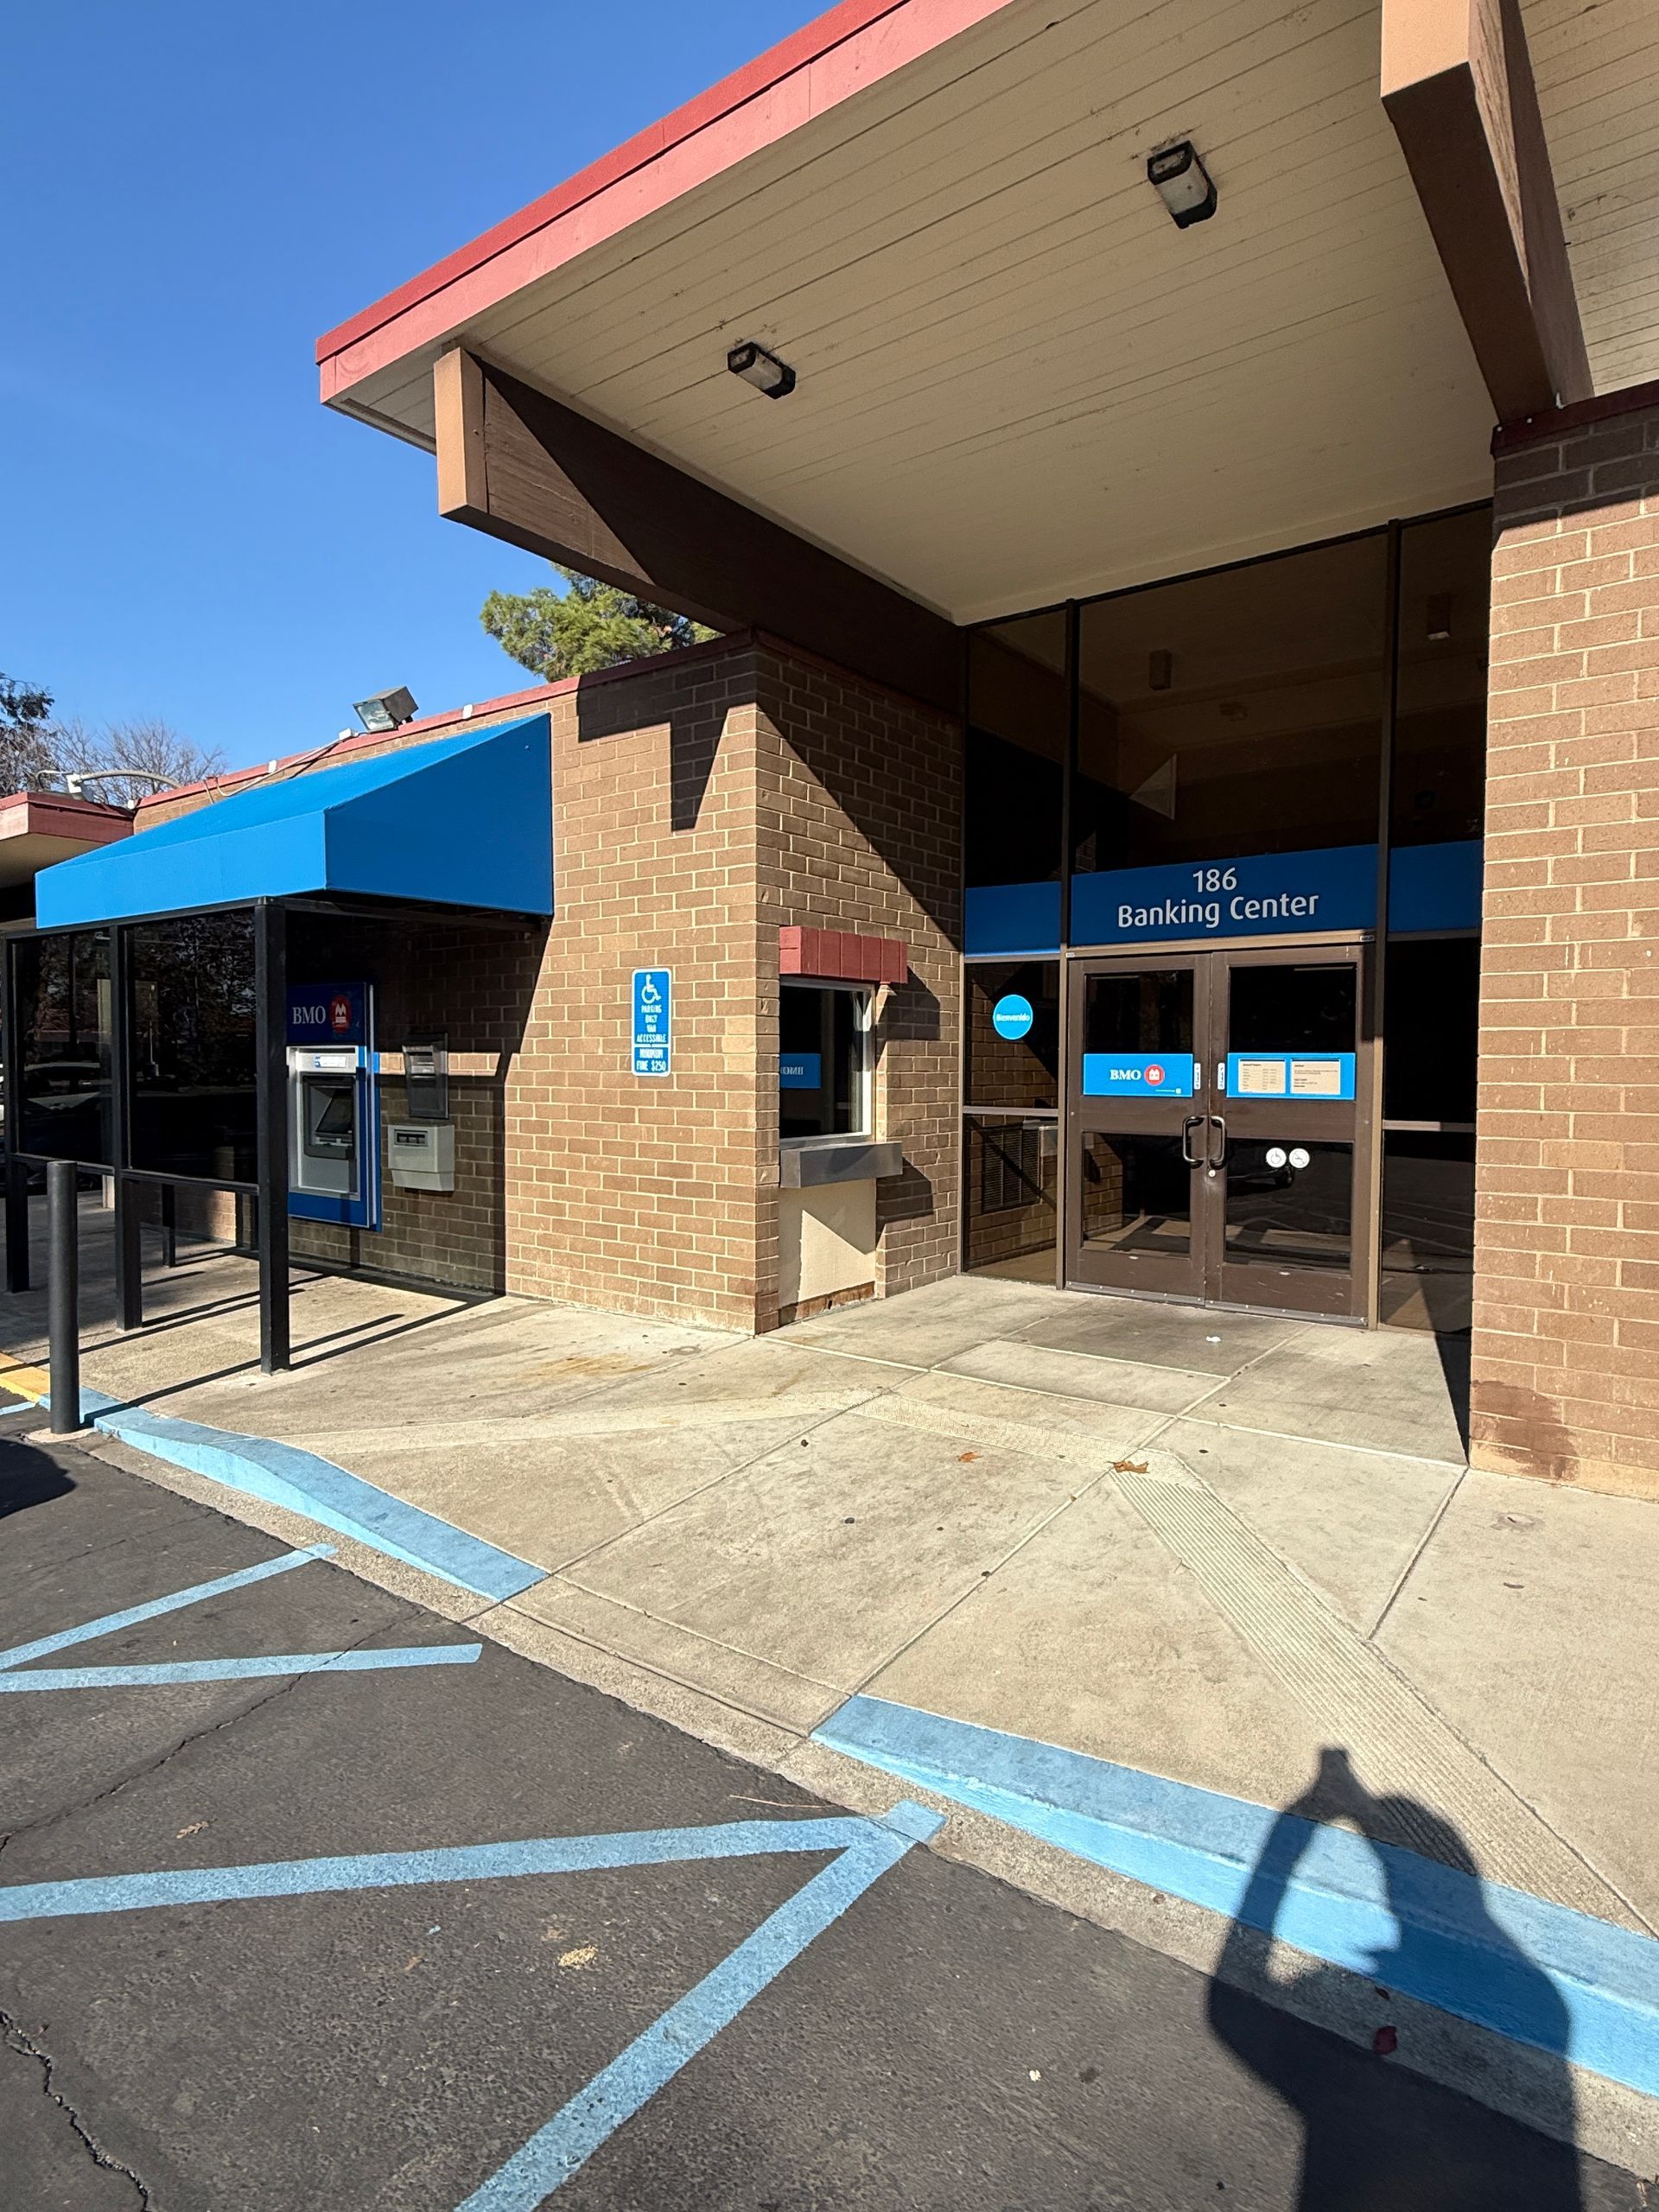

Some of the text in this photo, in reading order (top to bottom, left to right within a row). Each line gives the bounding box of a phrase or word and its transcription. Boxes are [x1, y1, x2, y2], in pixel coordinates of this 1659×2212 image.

[1192, 867, 1237, 893] 186
[1118, 893, 1319, 928] Banking Center
[292, 1005, 327, 1024] BMO
[641, 1005, 662, 1014] PARKING
[637, 1033, 666, 1043] ACCESSIBLE
[637, 1059, 666, 1071] FINE $250
[1109, 1069, 1141, 1080] BMO
